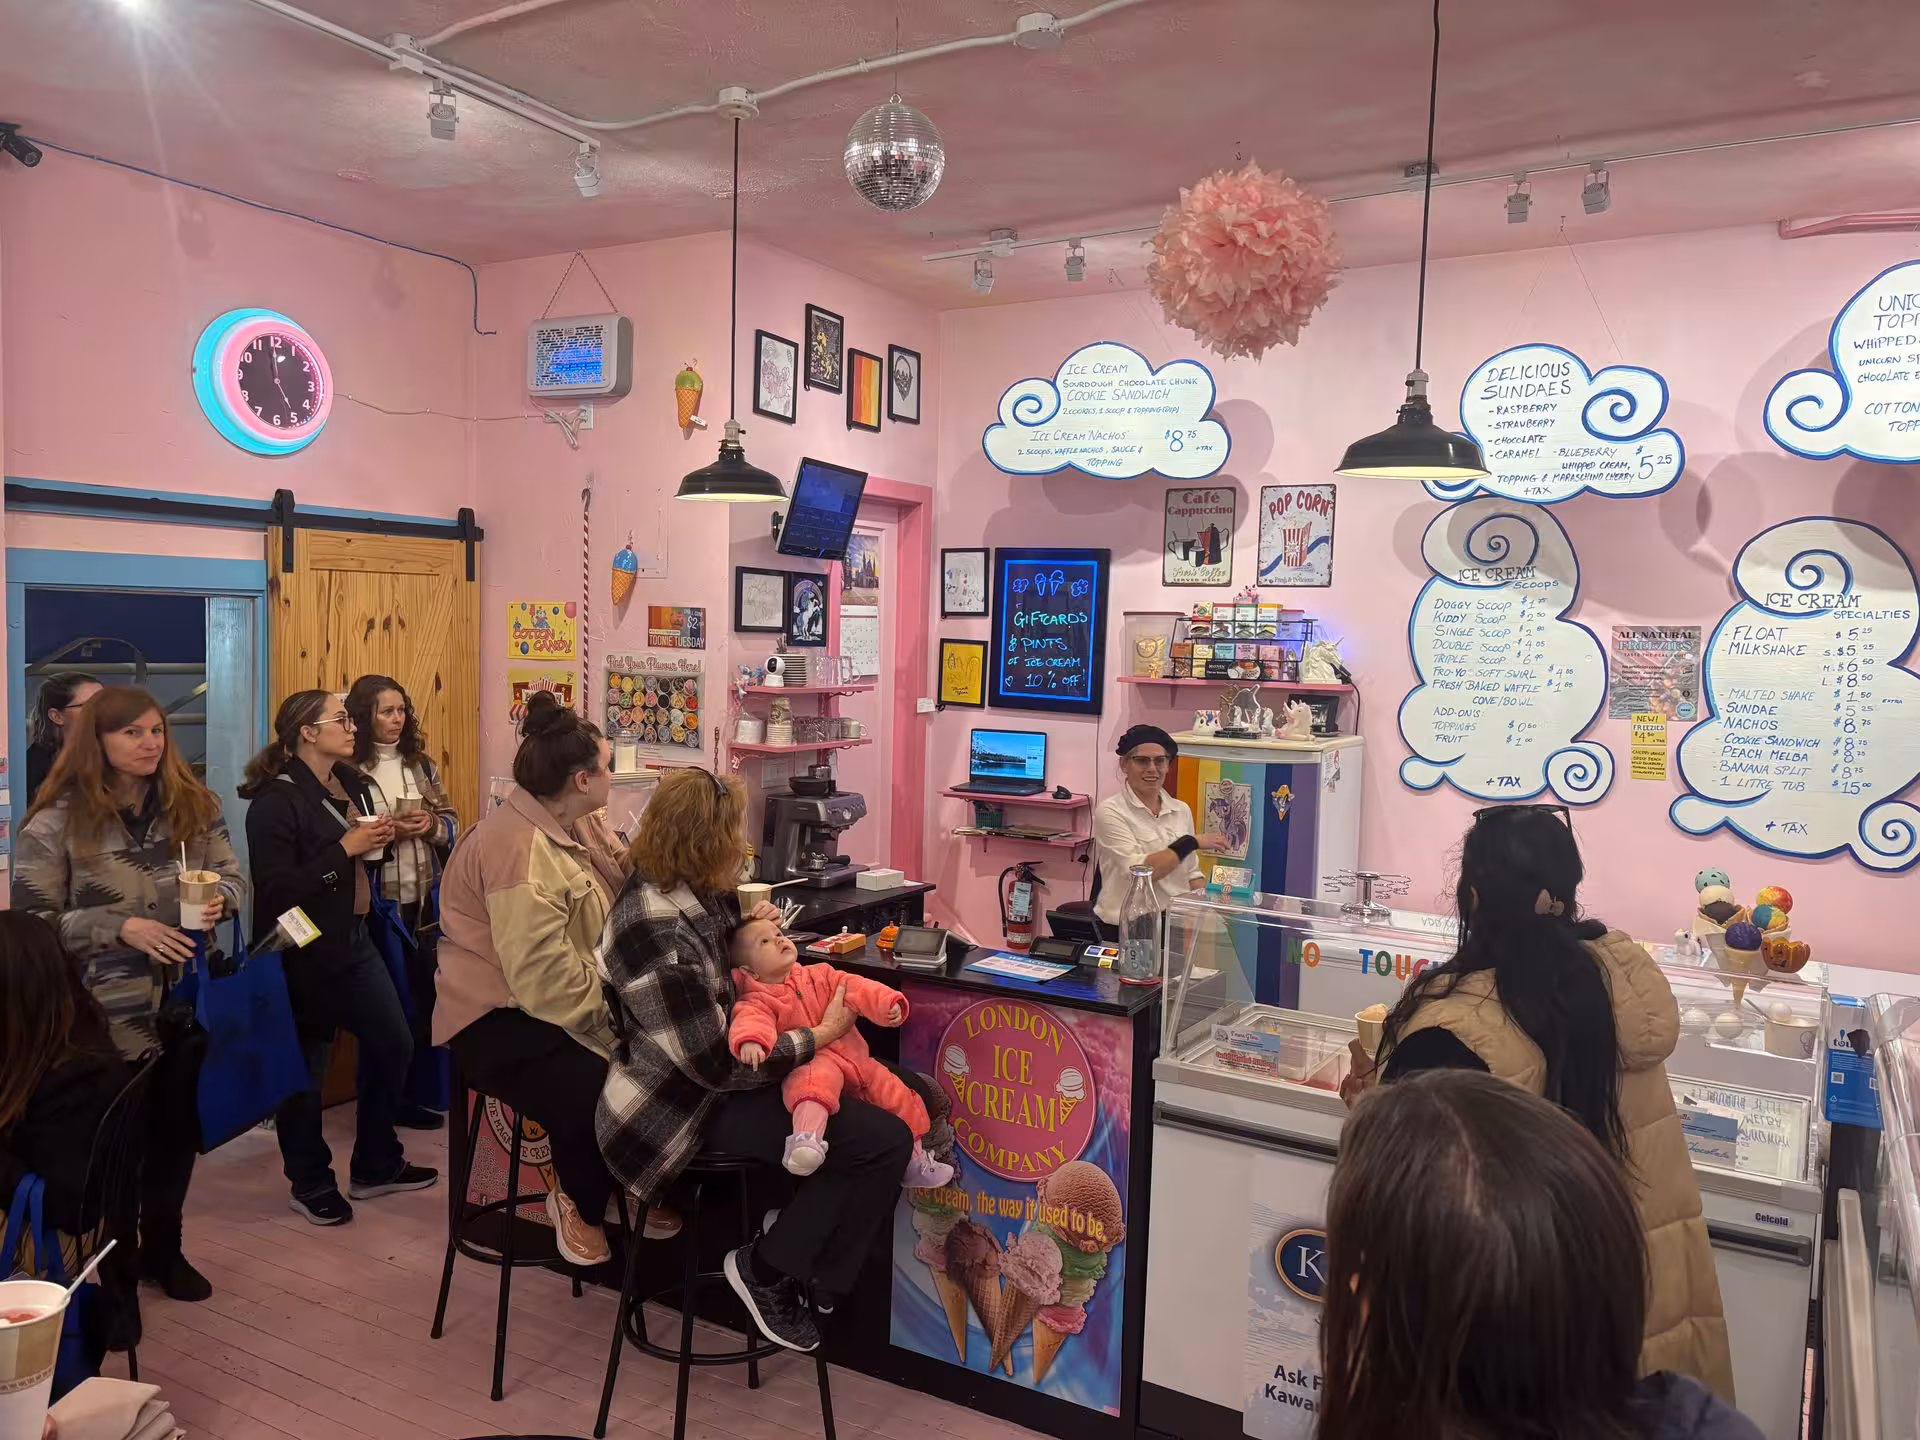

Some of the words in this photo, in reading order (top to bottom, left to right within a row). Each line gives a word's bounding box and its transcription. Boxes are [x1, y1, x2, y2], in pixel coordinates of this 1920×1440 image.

[253, 339, 263, 351] 11
[270, 335, 282, 349] 12
[292, 345, 296, 357] 1
[302, 360, 311, 373] 2
[1066, 363, 1088, 375] ICE
[1092, 362, 1128, 375] CREAM
[1486, 361, 1571, 383] DELICIOUS
[307, 380, 315, 393] 3
[1062, 379, 1113, 388] SOURDOUGH
[1118, 378, 1167, 388] CHOCOLATE
[1169, 378, 1198, 386] CHUNK
[1480, 379, 1572, 400] SUNDAES
[241, 389, 249, 402] 8
[1066, 389, 1106, 402] COOKIE
[1113, 389, 1172, 401] SANDWICH
[302, 398, 311, 410] 4
[254, 405, 263, 418] 7
[290, 411, 298, 424] 5
[272, 414, 281, 426] 6
[1030, 430, 1050, 442] ICE
[1053, 429, 1086, 441] CREAM
[1111, 445, 1135, 454] SAUCE
[1086, 458, 1124, 468] TOPPING
[1497, 474, 1537, 484] TOPPING
[1182, 490, 1221, 505] Café
[1167, 505, 1233, 517] Cappuccino
[1268, 492, 1293, 521] POP
[1296, 490, 1331, 518] CORN
[1459, 568, 1481, 581] ICE
[1485, 566, 1537, 581] CREAM
[1434, 598, 1471, 610] DOGGY
[1476, 599, 1512, 612] SCOOP
[1765, 592, 1793, 608] ICE
[1797, 594, 1862, 609] CREAM
[1433, 611, 1467, 623] KIDDY
[1475, 613, 1507, 625] SCOOP
[1833, 610, 1911, 620] SPECIALTIES
[513, 628, 555, 640] COTTON
[1434, 624, 1475, 637] SINGLE
[1479, 628, 1512, 638] SCOOP
[1618, 630, 1640, 640] ALL
[1641, 630, 1694, 640] NATURAL
[1733, 625, 1790, 641] FLOAT
[649, 635, 673, 647] TOONIE
[673, 636, 705, 648] TUESDAY
[1021, 637, 1068, 652] PINTS
[1432, 638, 1474, 651] DOUBLE
[1479, 643, 1511, 653] SCOOP
[1618, 641, 1692, 651] FREEZIES
[1728, 642, 1808, 657] MILKSHAKE
[606, 655, 625, 669] Find
[625, 655, 646, 671] Your
[646, 656, 677, 672] Flavour
[1024, 657, 1045, 667] ICE
[1045, 657, 1081, 667] CREAM
[1433, 653, 1469, 664] TRIPLE
[1433, 666, 1467, 678] FRO-YO
[1475, 669, 1505, 679] SOFT
[1504, 669, 1537, 680] SWIRL
[1432, 679, 1464, 691] FRESH
[1465, 680, 1501, 692] BAKED
[1504, 683, 1542, 693] WAFFLE
[1728, 688, 1776, 701] MALTED
[1780, 690, 1816, 702] SHAKE
[1725, 701, 1779, 716] SUNDAE
[1432, 720, 1477, 731] TOPPINGS
[1723, 717, 1779, 731] NACHOS
[1434, 734, 1469, 743] FRUIT
[1724, 732, 1762, 746] COOKIE
[1764, 735, 1822, 748] SANDWICH
[1721, 745, 1762, 760] PEACH
[1769, 751, 1809, 762] MELBA
[1719, 760, 1769, 775] BANANA
[1774, 765, 1814, 777] SPLIT
[1497, 776, 1522, 788] TAX
[1736, 778, 1775, 791] LITRE
[1781, 781, 1806, 792] TUB
[1781, 822, 1809, 836] TAX
[1286, 937, 1321, 968] NO
[1358, 948, 1446, 981] TOUC
[963, 1004, 1066, 1057] LONDON
[992, 1044, 1034, 1086] ICE
[966, 1080, 1057, 1133] CREAM
[954, 1117, 1068, 1173] COMPANY
[977, 1191, 996, 1216] the
[998, 1197, 1022, 1220] way
[1026, 1195, 1037, 1222] it
[1038, 1203, 1069, 1228] used
[1072, 1210, 1085, 1233] to
[1273, 1364, 1309, 1388] Ask
